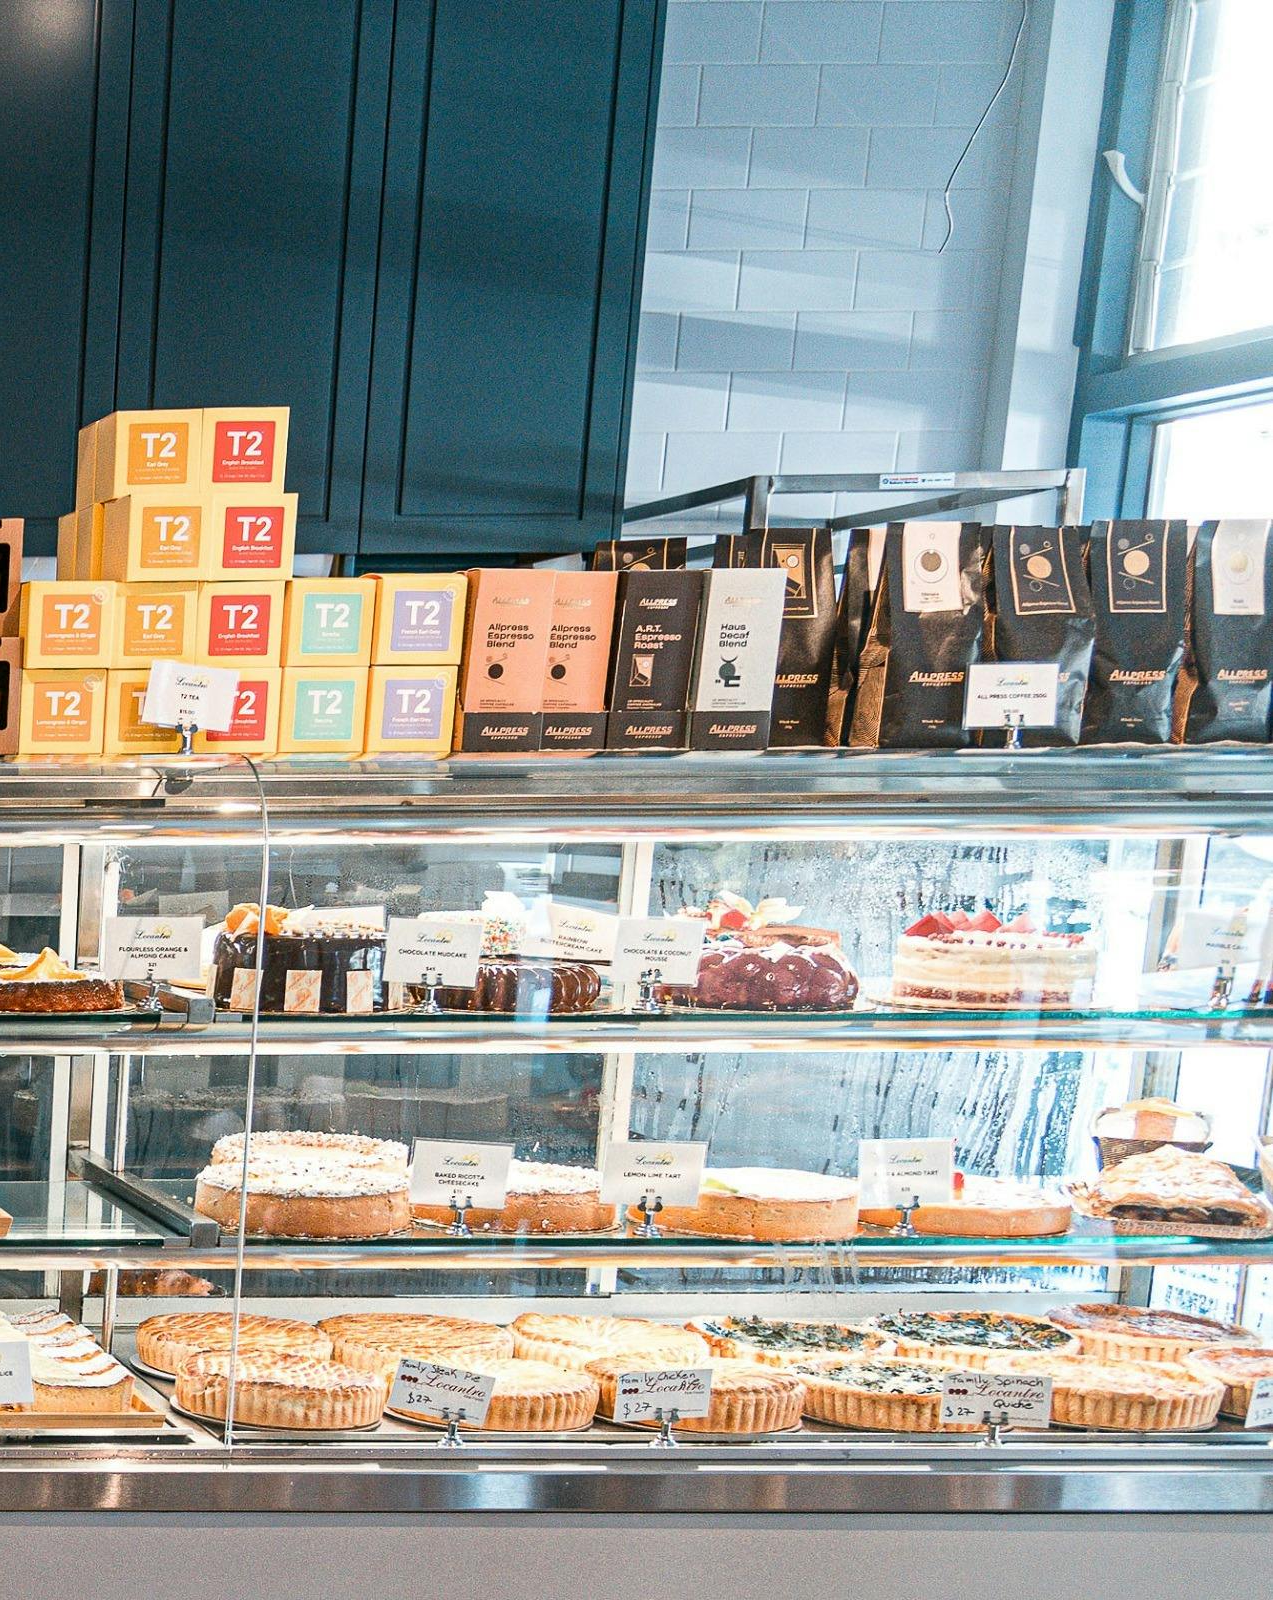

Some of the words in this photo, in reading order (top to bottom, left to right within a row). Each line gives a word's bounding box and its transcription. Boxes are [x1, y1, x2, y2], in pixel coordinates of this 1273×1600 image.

[140, 432, 177, 458] T2
[226, 431, 263, 456] T2
[153, 516, 190, 542] T2
[237, 516, 272, 542] T2
[639, 598, 678, 606] ALLPRESS
[54, 604, 90, 629] T2
[137, 605, 173, 630] T2
[222, 604, 259, 629] T2
[315, 603, 350, 628] T2
[405, 601, 440, 626] T2
[488, 623, 529, 632] Allpress
[551, 625, 591, 633] Allpress
[635, 624, 662, 633] A.R.T.
[720, 623, 746, 631] Haus
[487, 632, 534, 642] Espresso
[550, 633, 597, 643] Espresso
[634, 633, 682, 642] Espresso
[719, 631, 750, 639] Decaf
[634, 641, 664, 649] Roast
[718, 640, 748, 648] Blend
[776, 674, 818, 685] LLPRESS
[908, 671, 965, 683] ALLPRESS
[1109, 669, 1166, 682] ALLPRESS
[1217, 669, 1268, 681] ALLPRESS
[45, 691, 81, 716] T2
[307, 689, 343, 715] T2
[396, 689, 431, 714] T2
[480, 726, 529, 736] ALLPRESS
[544, 726, 592, 736] ALLPRESS
[625, 726, 673, 735] ALLPRESS
[708, 724, 757, 734] ALLPRESS
[398, 948, 436, 956] CHOCOLATE
[436, 950, 468, 958] MUDCAKE
[438, 1179, 479, 1187] CHEESECAKE
[400, 1359, 427, 1374] Family
[431, 1364, 458, 1379] Steak
[619, 1373, 654, 1385] Family
[657, 1371, 696, 1381] Chicken
[948, 1374, 988, 1386] Family
[994, 1375, 1044, 1387] Spinach
[425, 1372, 486, 1398] Locantro
[976, 1385, 1044, 1398] Locantro
[406, 1392, 432, 1404] $27
[993, 1399, 1034, 1410] Quiche
